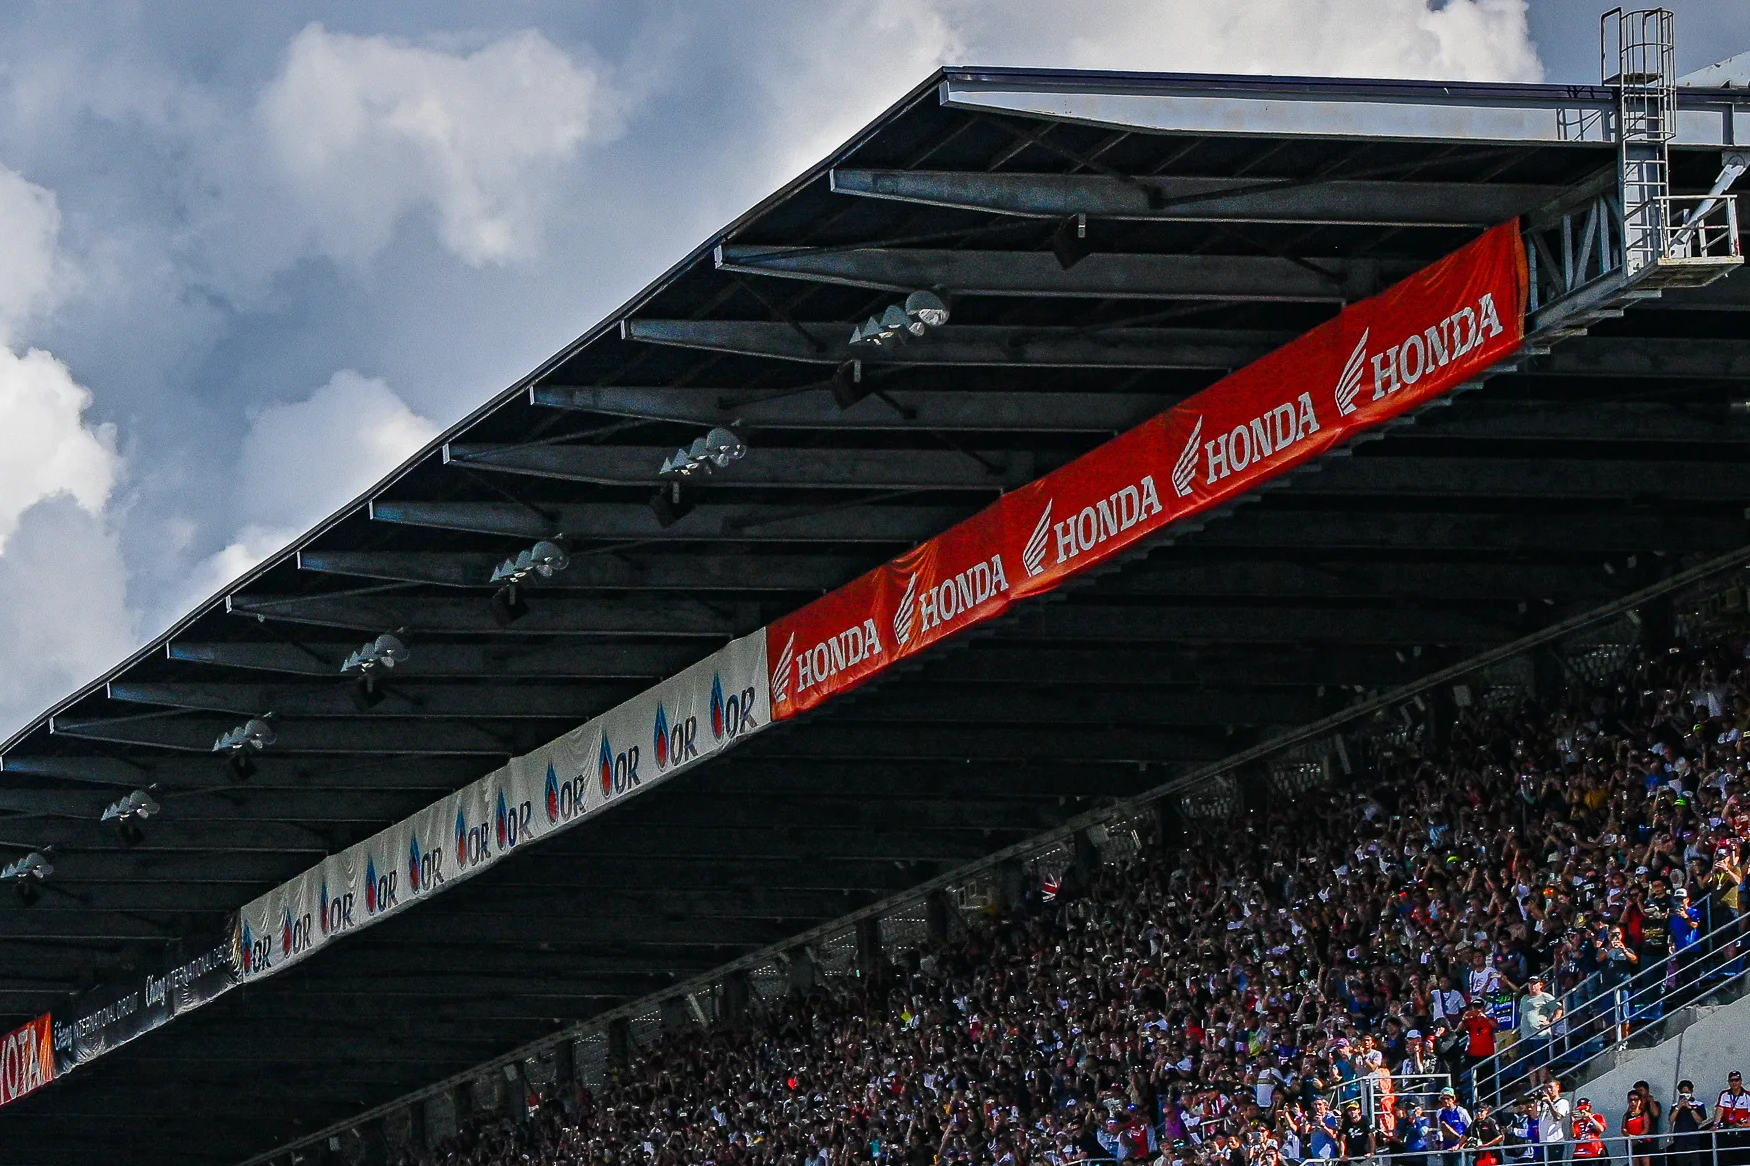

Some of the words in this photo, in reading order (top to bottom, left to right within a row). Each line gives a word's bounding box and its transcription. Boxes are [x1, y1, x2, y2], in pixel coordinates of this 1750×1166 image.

[1372, 294, 1503, 401] HONDA
[1206, 392, 1320, 484] HONDA
[1054, 475, 1162, 565] HONDA
[921, 554, 1008, 633] HONDA
[797, 619, 882, 693] HONDA
[727, 686, 758, 738] OR
[670, 715, 698, 766] OR
[614, 746, 641, 792] OR
[560, 774, 587, 820] OR
[468, 822, 491, 865] OR
[508, 800, 534, 845] OR
[377, 870, 398, 909] OR
[421, 847, 444, 888] OR
[293, 914, 311, 952] OR
[331, 893, 354, 931] OR
[252, 935, 272, 973] OR
